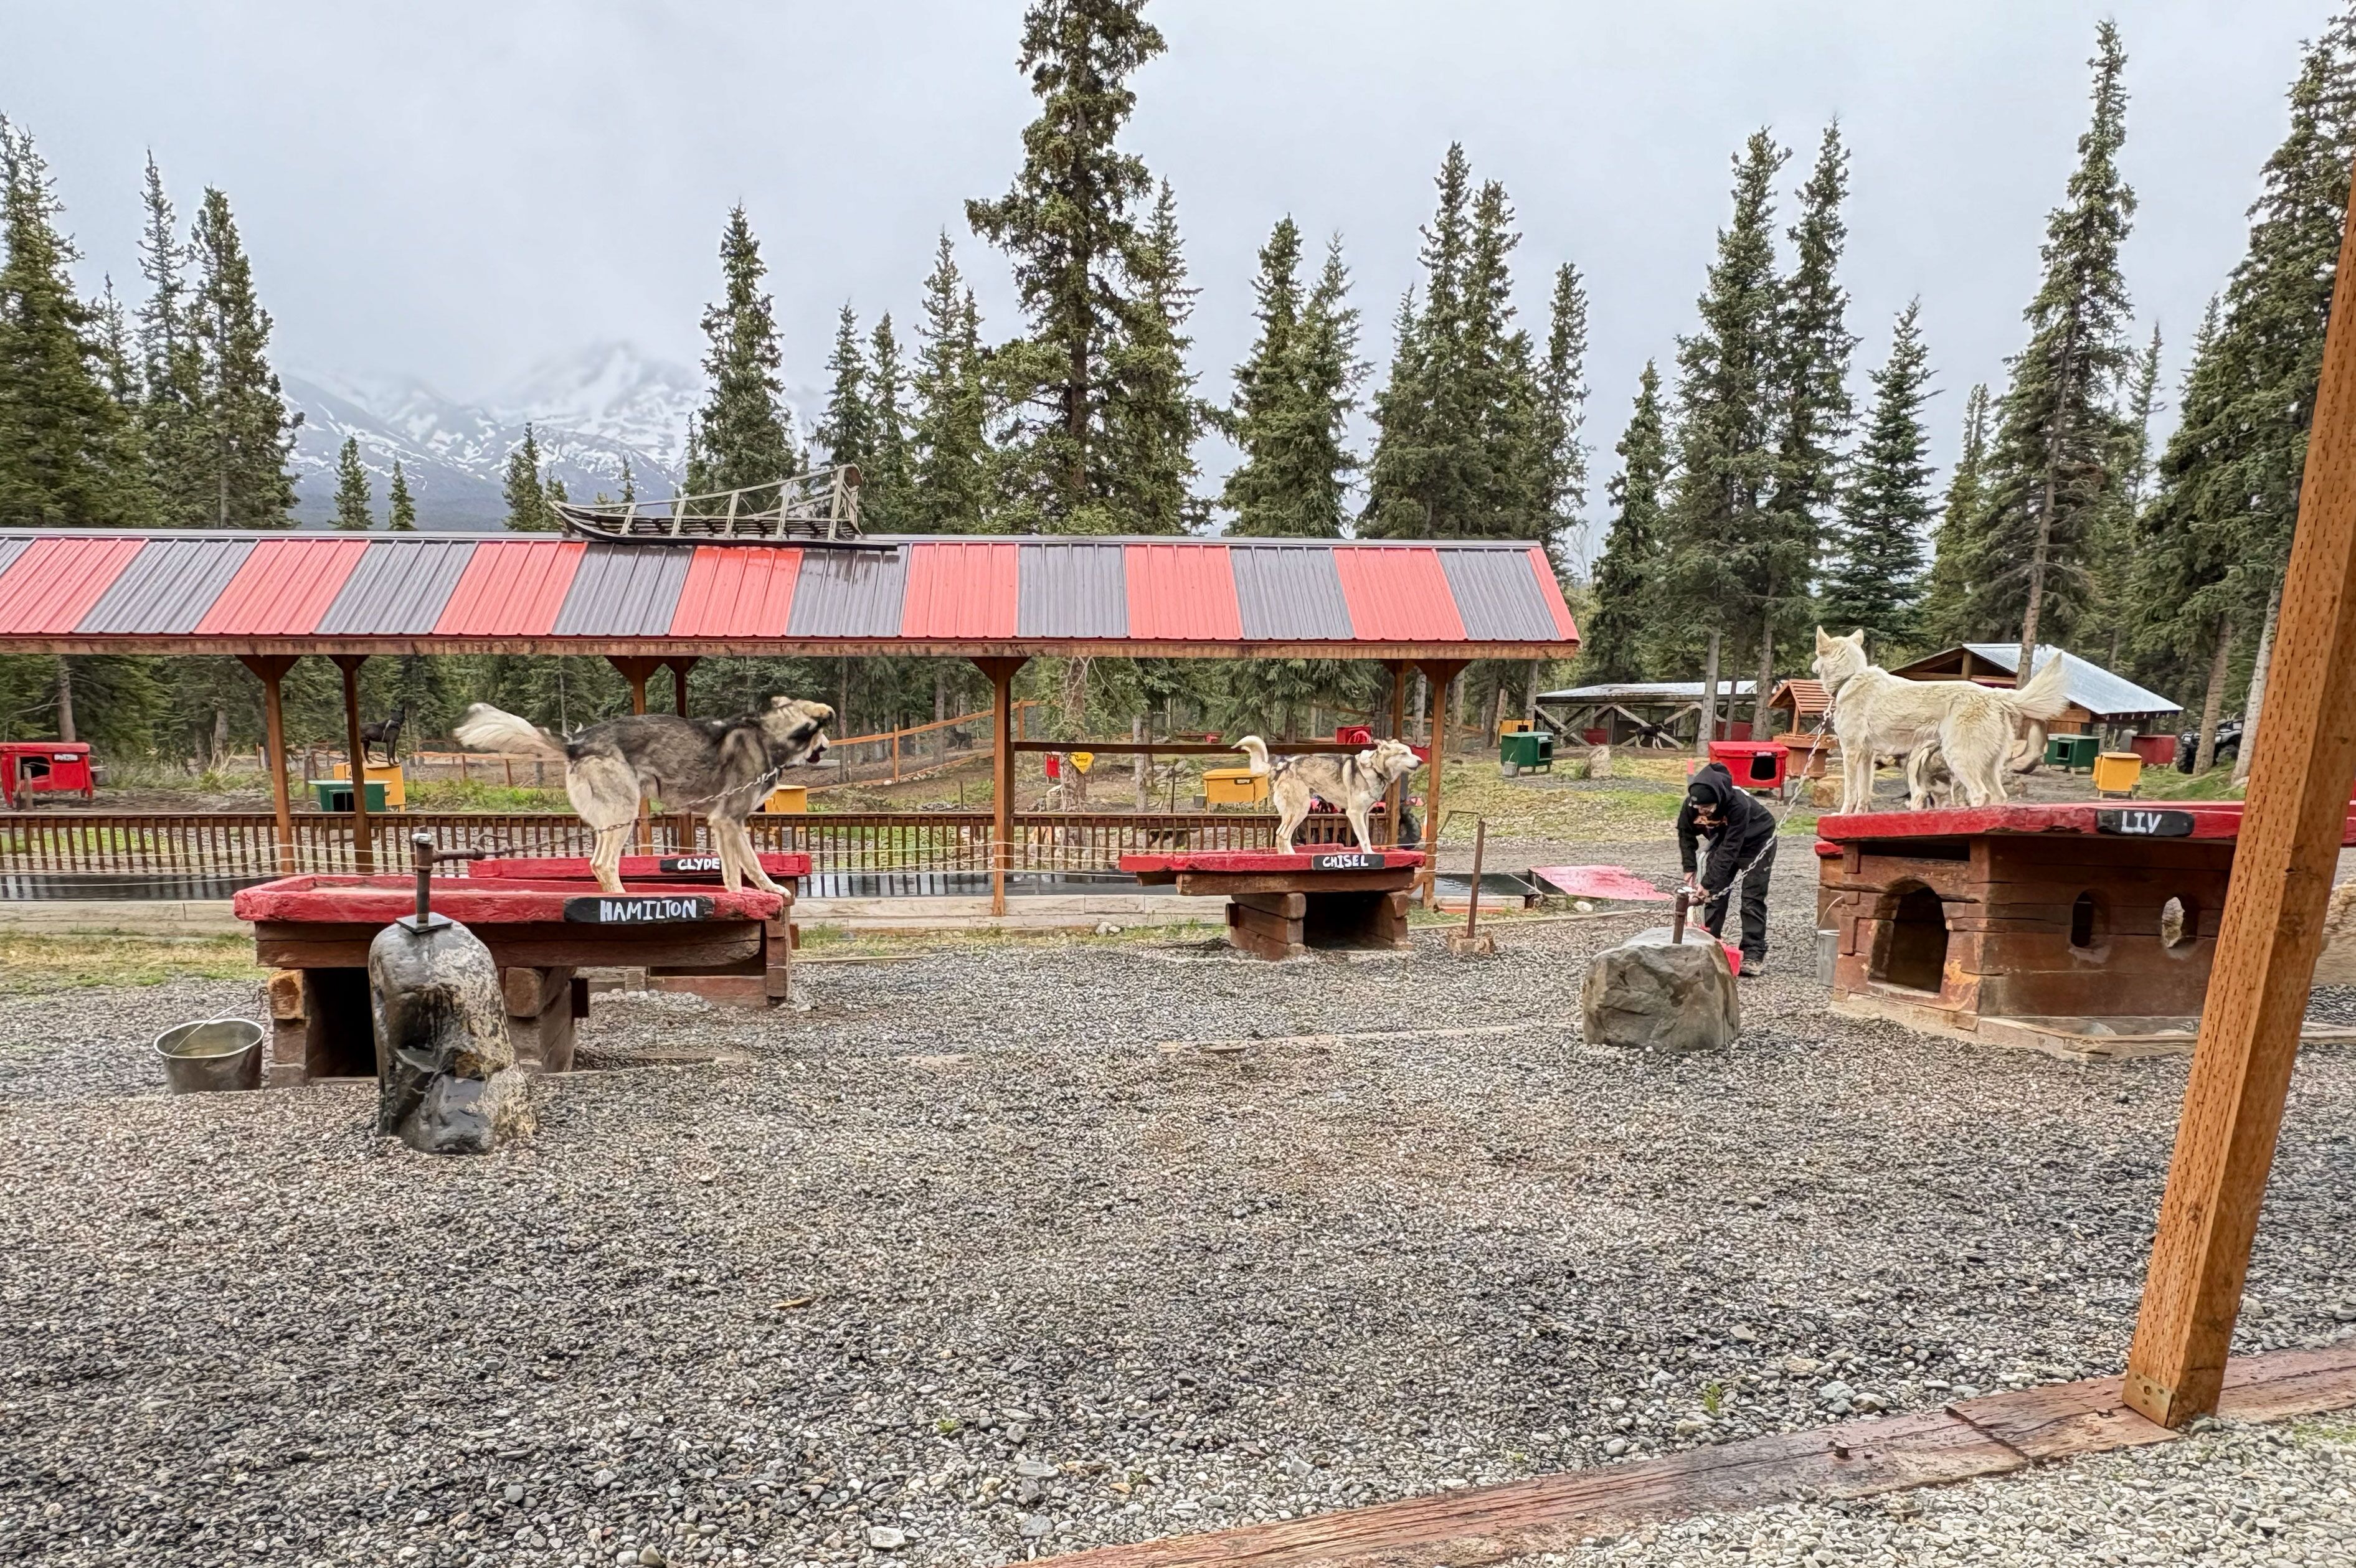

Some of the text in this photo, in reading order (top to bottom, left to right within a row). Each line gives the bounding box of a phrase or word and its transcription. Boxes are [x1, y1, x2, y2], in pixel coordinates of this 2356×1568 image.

[2121, 811, 2162, 833] LIV
[677, 857, 721, 871] CLYDE
[1322, 854, 1369, 869] CHISEL
[600, 900, 696, 922] HAMILTON
